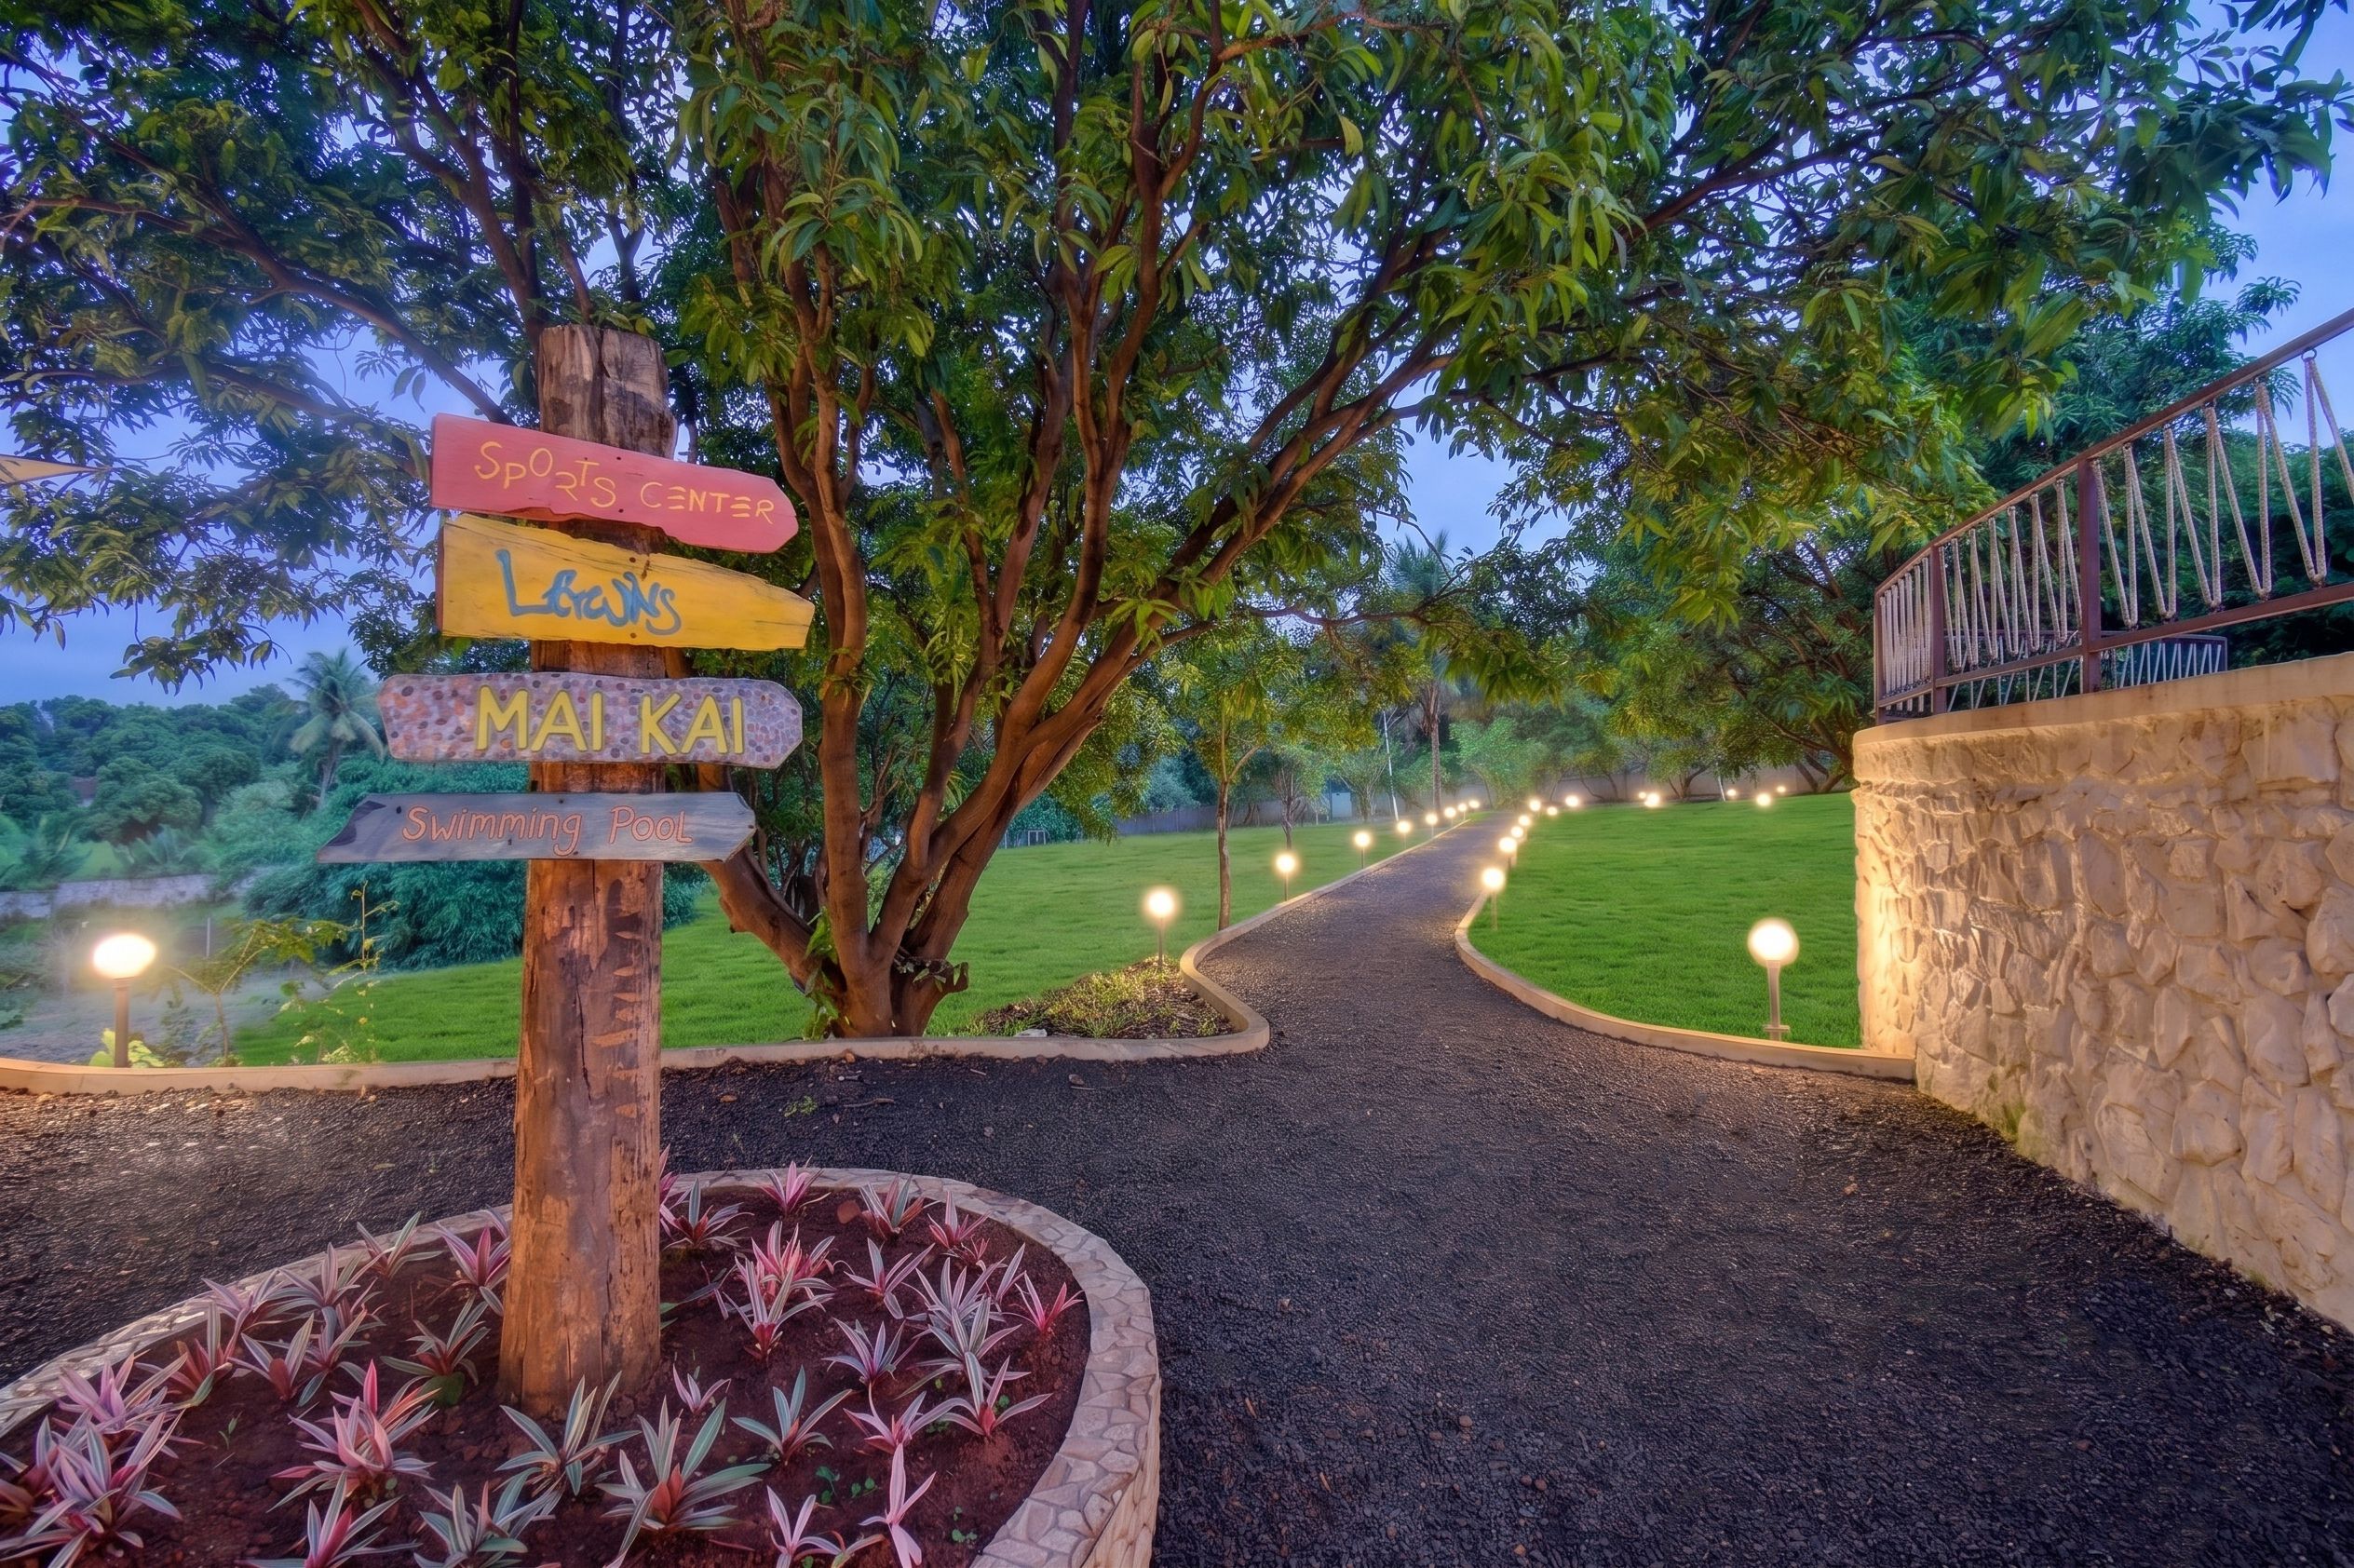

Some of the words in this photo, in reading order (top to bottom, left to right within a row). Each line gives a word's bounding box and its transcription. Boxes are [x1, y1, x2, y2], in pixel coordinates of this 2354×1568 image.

[640, 481, 775, 524] CENTER
[475, 684, 602, 751] MAI
[640, 692, 744, 755] KAI
[402, 805, 583, 856] Swimming
